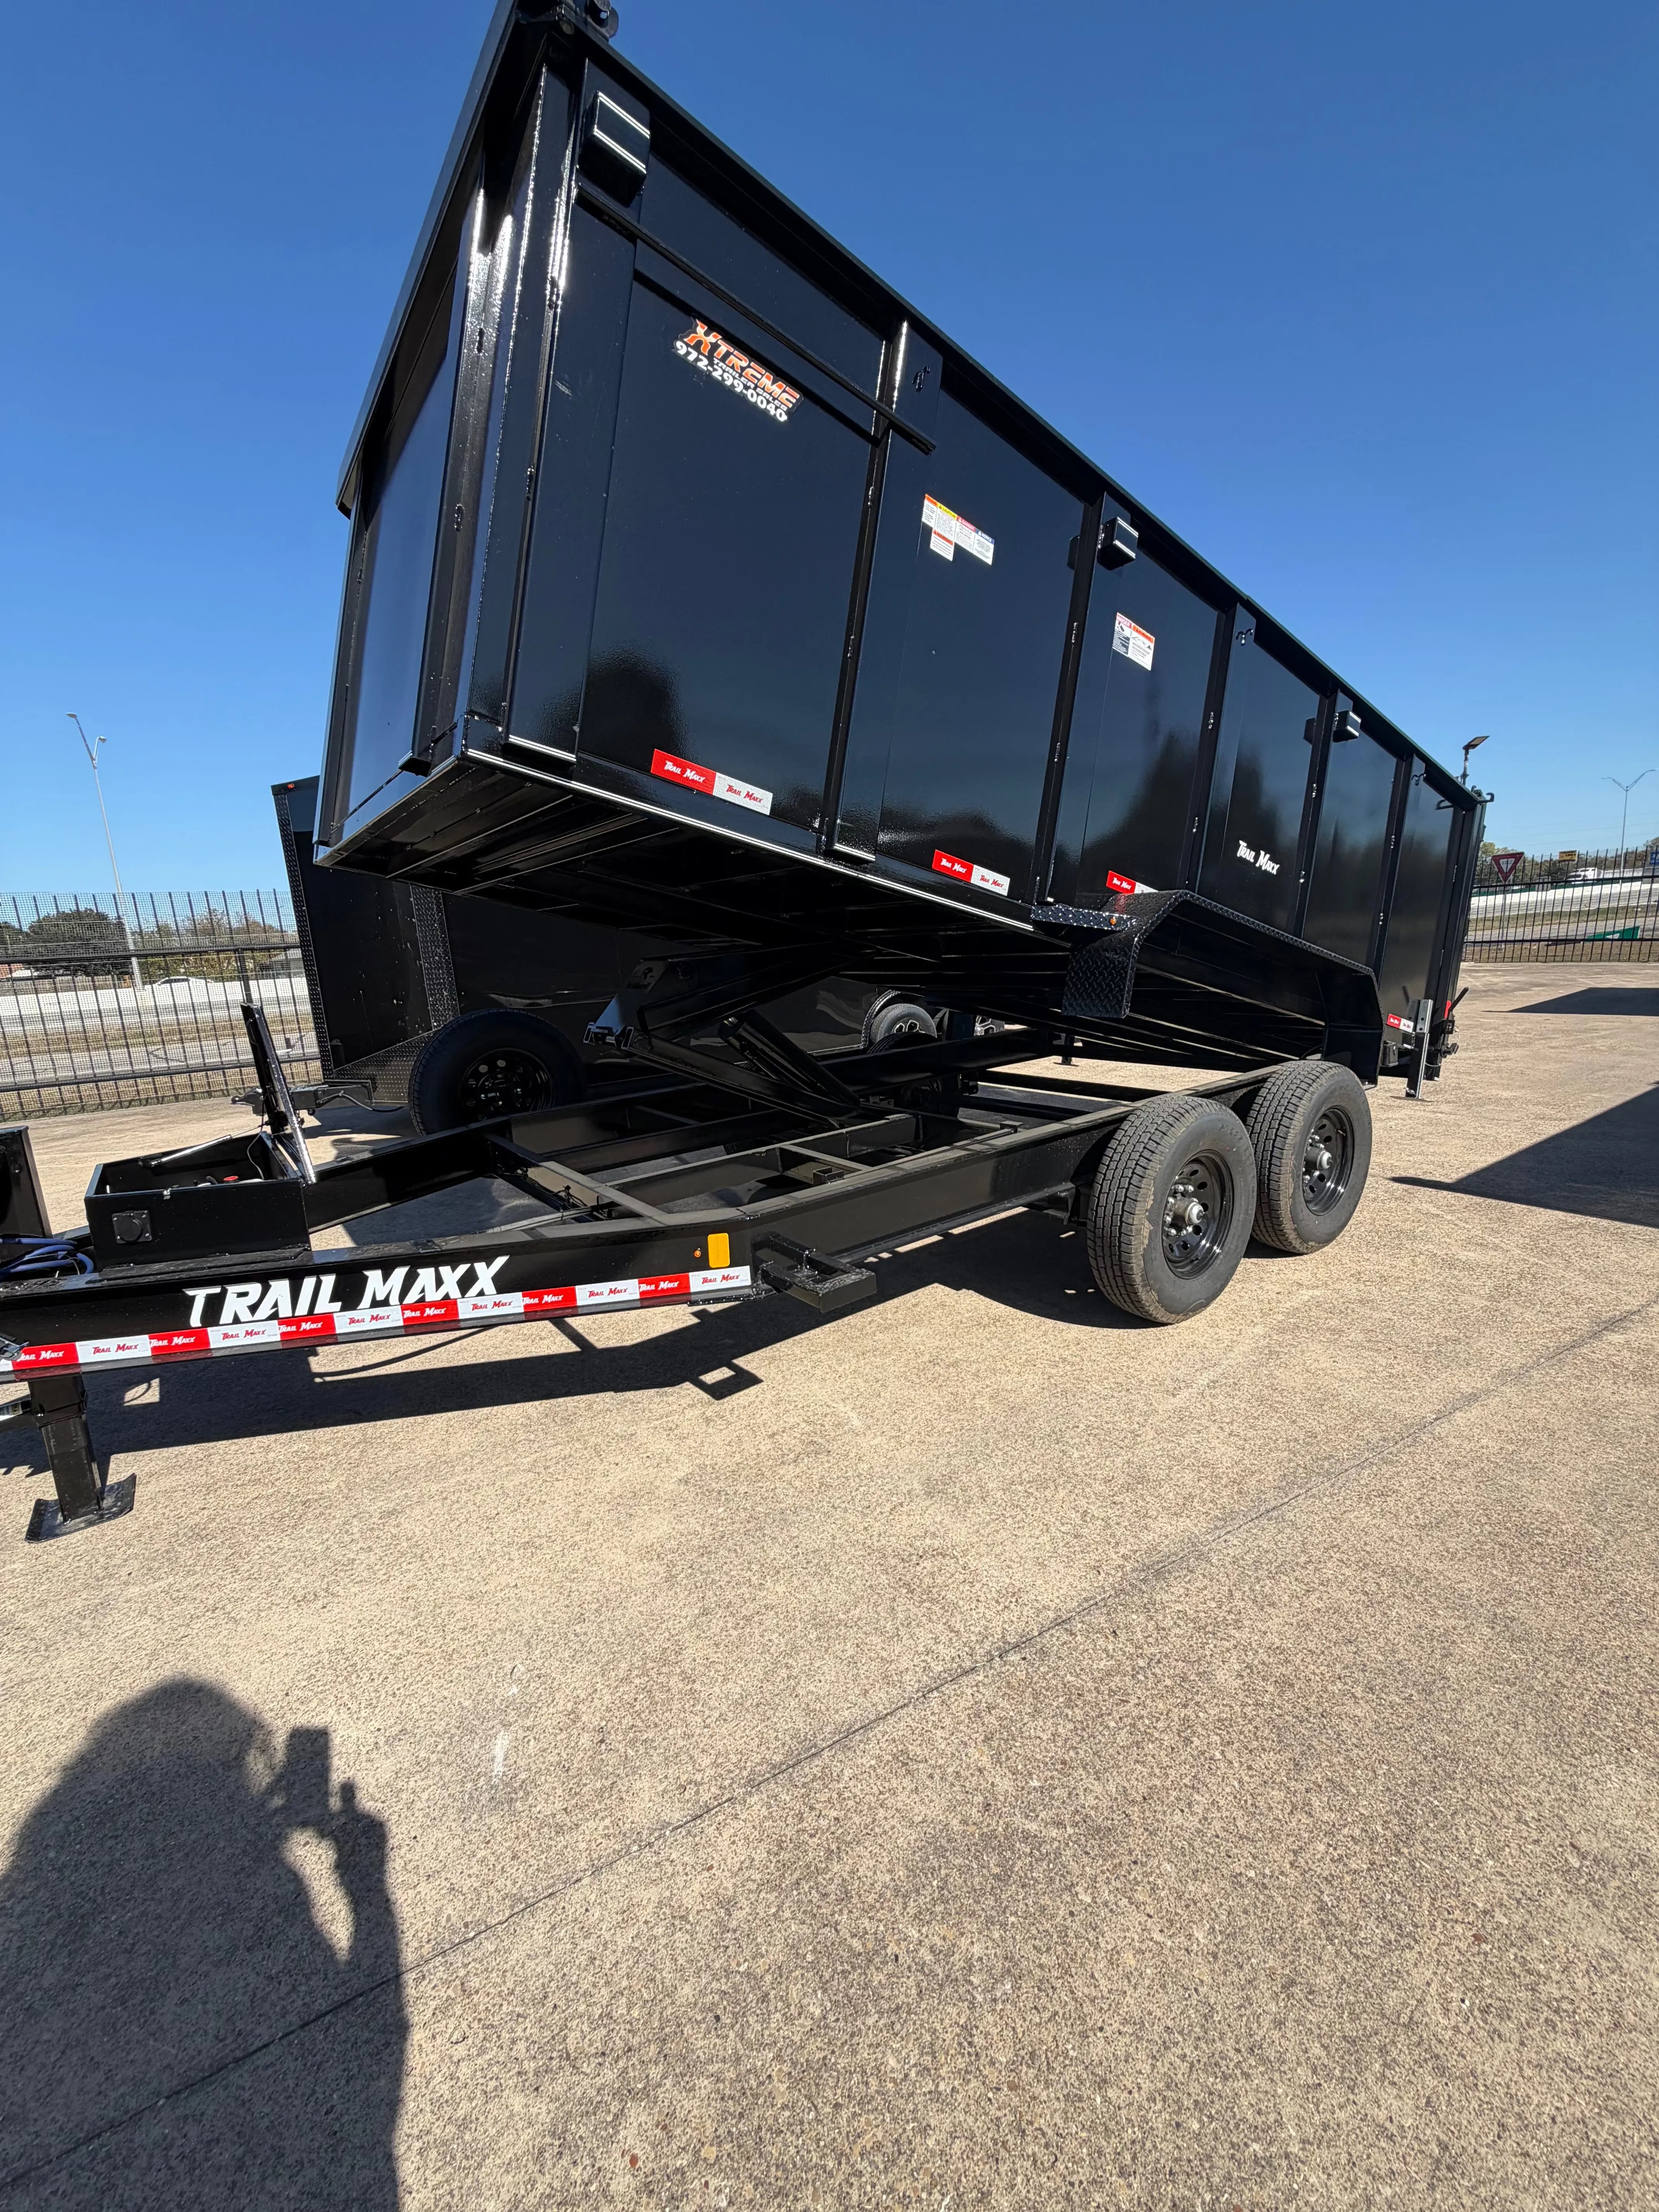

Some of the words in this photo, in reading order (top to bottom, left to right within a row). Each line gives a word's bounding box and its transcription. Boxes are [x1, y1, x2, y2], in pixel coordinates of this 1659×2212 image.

[684, 318, 800, 408] XTREME
[676, 340, 788, 422] 972-299-0040
[713, 357, 755, 389] TRAILER
[756, 388, 788, 411] SALES
[664, 761, 682, 775] TRAIL
[683, 768, 706, 783] MAXX
[726, 785, 741, 796] TRAIL
[744, 791, 763, 804] MAXX
[1237, 840, 1255, 862] TRAIL
[1255, 850, 1280, 875] MAXX
[720, 1274, 740, 1282] MAXX
[184, 1274, 342, 1327] TRAIL
[358, 1255, 510, 1309] MAXX
[658, 1281, 679, 1290] MAXX
[607, 1287, 628, 1296] MAXX
[491, 1300, 513, 1309] MAXX
[522, 1297, 539, 1305] TRAIL
[542, 1294, 563, 1303] MAXX
[369, 1314, 391, 1322] MAXX
[403, 1310, 421, 1318] TRAIL
[423, 1307, 446, 1316] MAXX
[299, 1322, 323, 1331] MAXX
[221, 1333, 240, 1341] TRAIL
[243, 1329, 267, 1338] MAXX
[149, 1338, 168, 1347] TRAIL
[171, 1336, 196, 1345] MAXX
[92, 1346, 111, 1355] TRAIL
[115, 1343, 139, 1353] MAXX
[39, 1350, 64, 1360] MAXX
